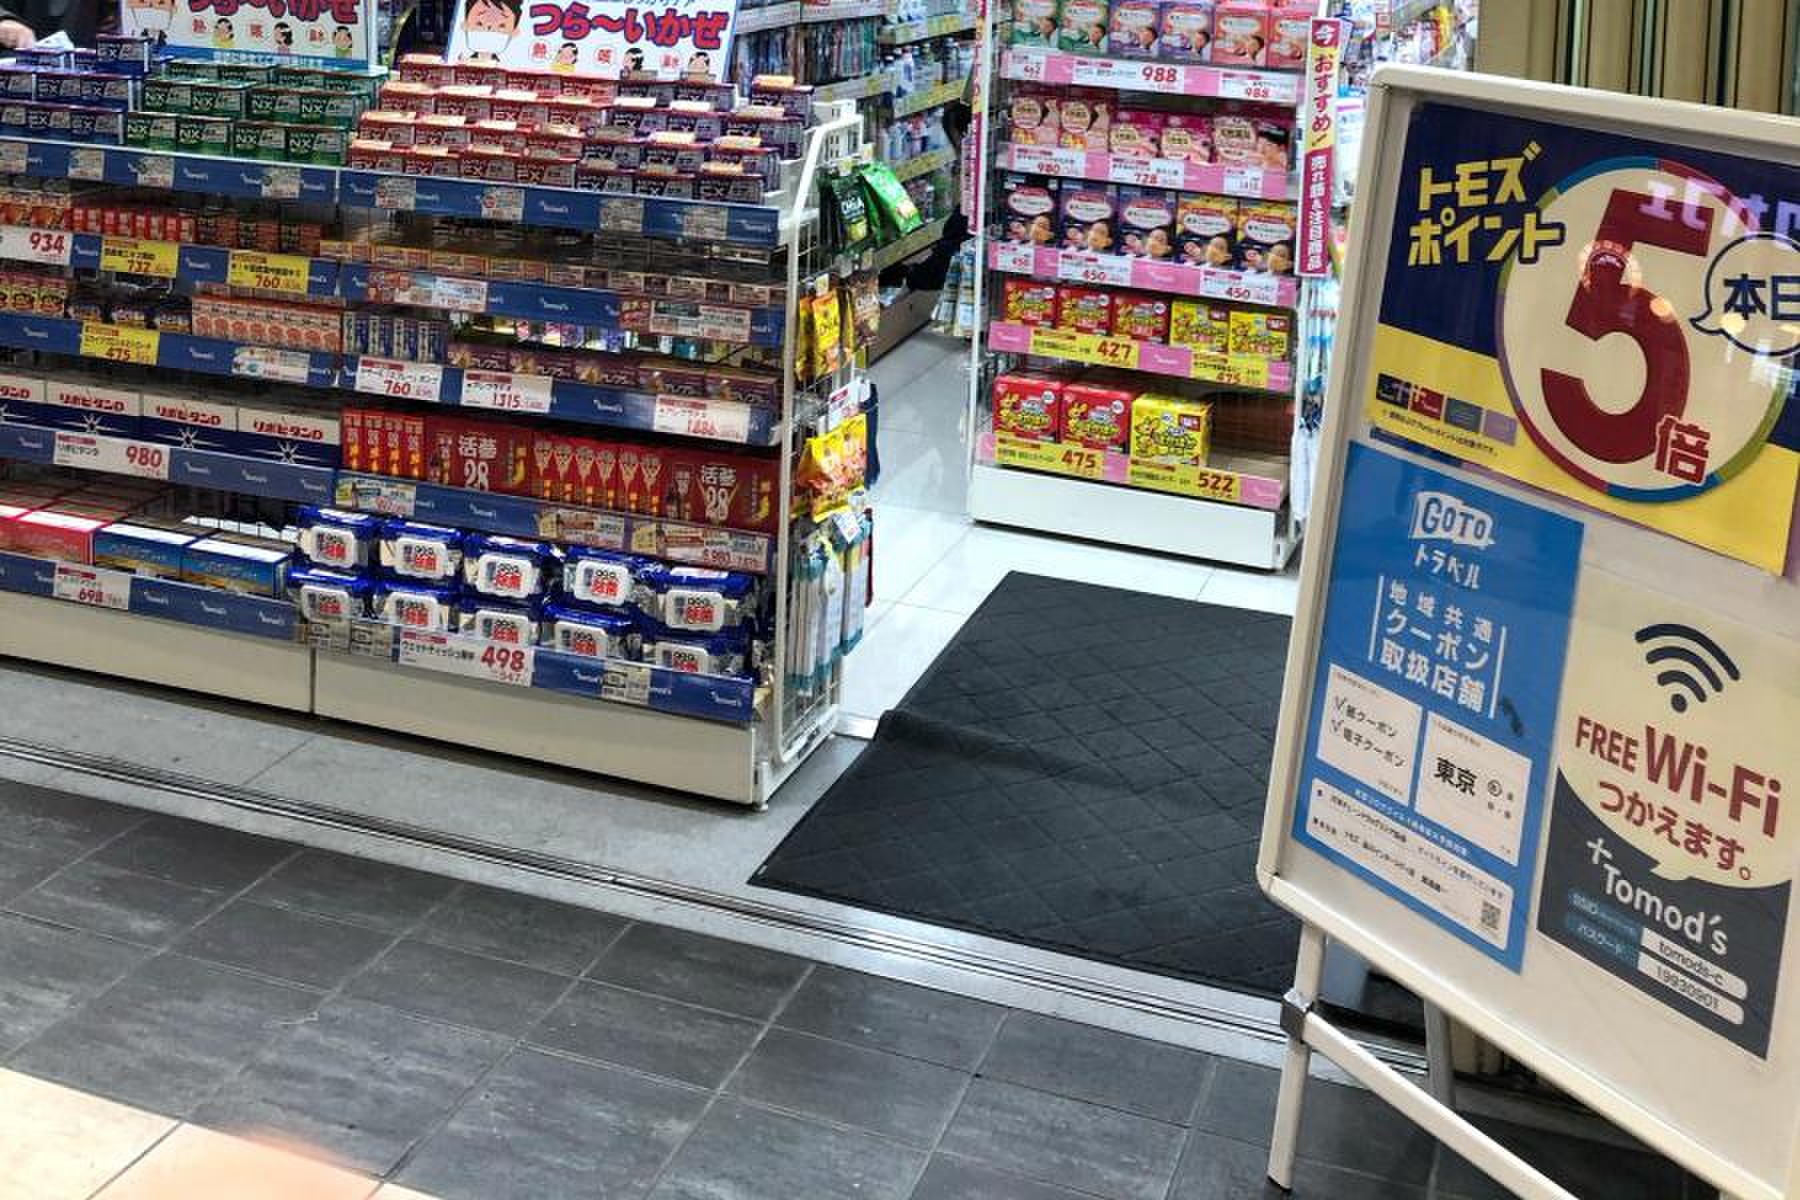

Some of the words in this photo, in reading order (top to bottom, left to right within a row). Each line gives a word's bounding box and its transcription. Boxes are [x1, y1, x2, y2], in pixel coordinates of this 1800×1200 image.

[1140, 65, 1179, 83] 988
[1418, 141, 1544, 212] トモズ
[30, 231, 65, 254] 934
[1408, 208, 1566, 267] ポイント
[1723, 272, 1800, 322] 本日
[1540, 188, 1716, 466] 5
[1097, 341, 1132, 358] 427
[59, 393, 125, 412] リポビタンD
[384, 379, 411, 396] 760
[155, 405, 221, 426] リポビタンD
[253, 419, 323, 440] リポビタンD
[126, 445, 162, 468] 980
[1061, 449, 1096, 468] 475
[1653, 414, 1712, 484] 倍
[1199, 472, 1234, 493] 522
[1414, 543, 1481, 590] トラベル
[481, 645, 525, 671] 498
[1386, 610, 1489, 670] クーポン
[1380, 638, 1486, 713] 取扱店舗
[1433, 756, 1479, 797] 東京
[1575, 716, 1640, 774] FREE
[1644, 724, 1782, 839] Wi-Fi
[1599, 780, 1752, 882] つかえます。
[1601, 864, 1729, 956] Tomod's
